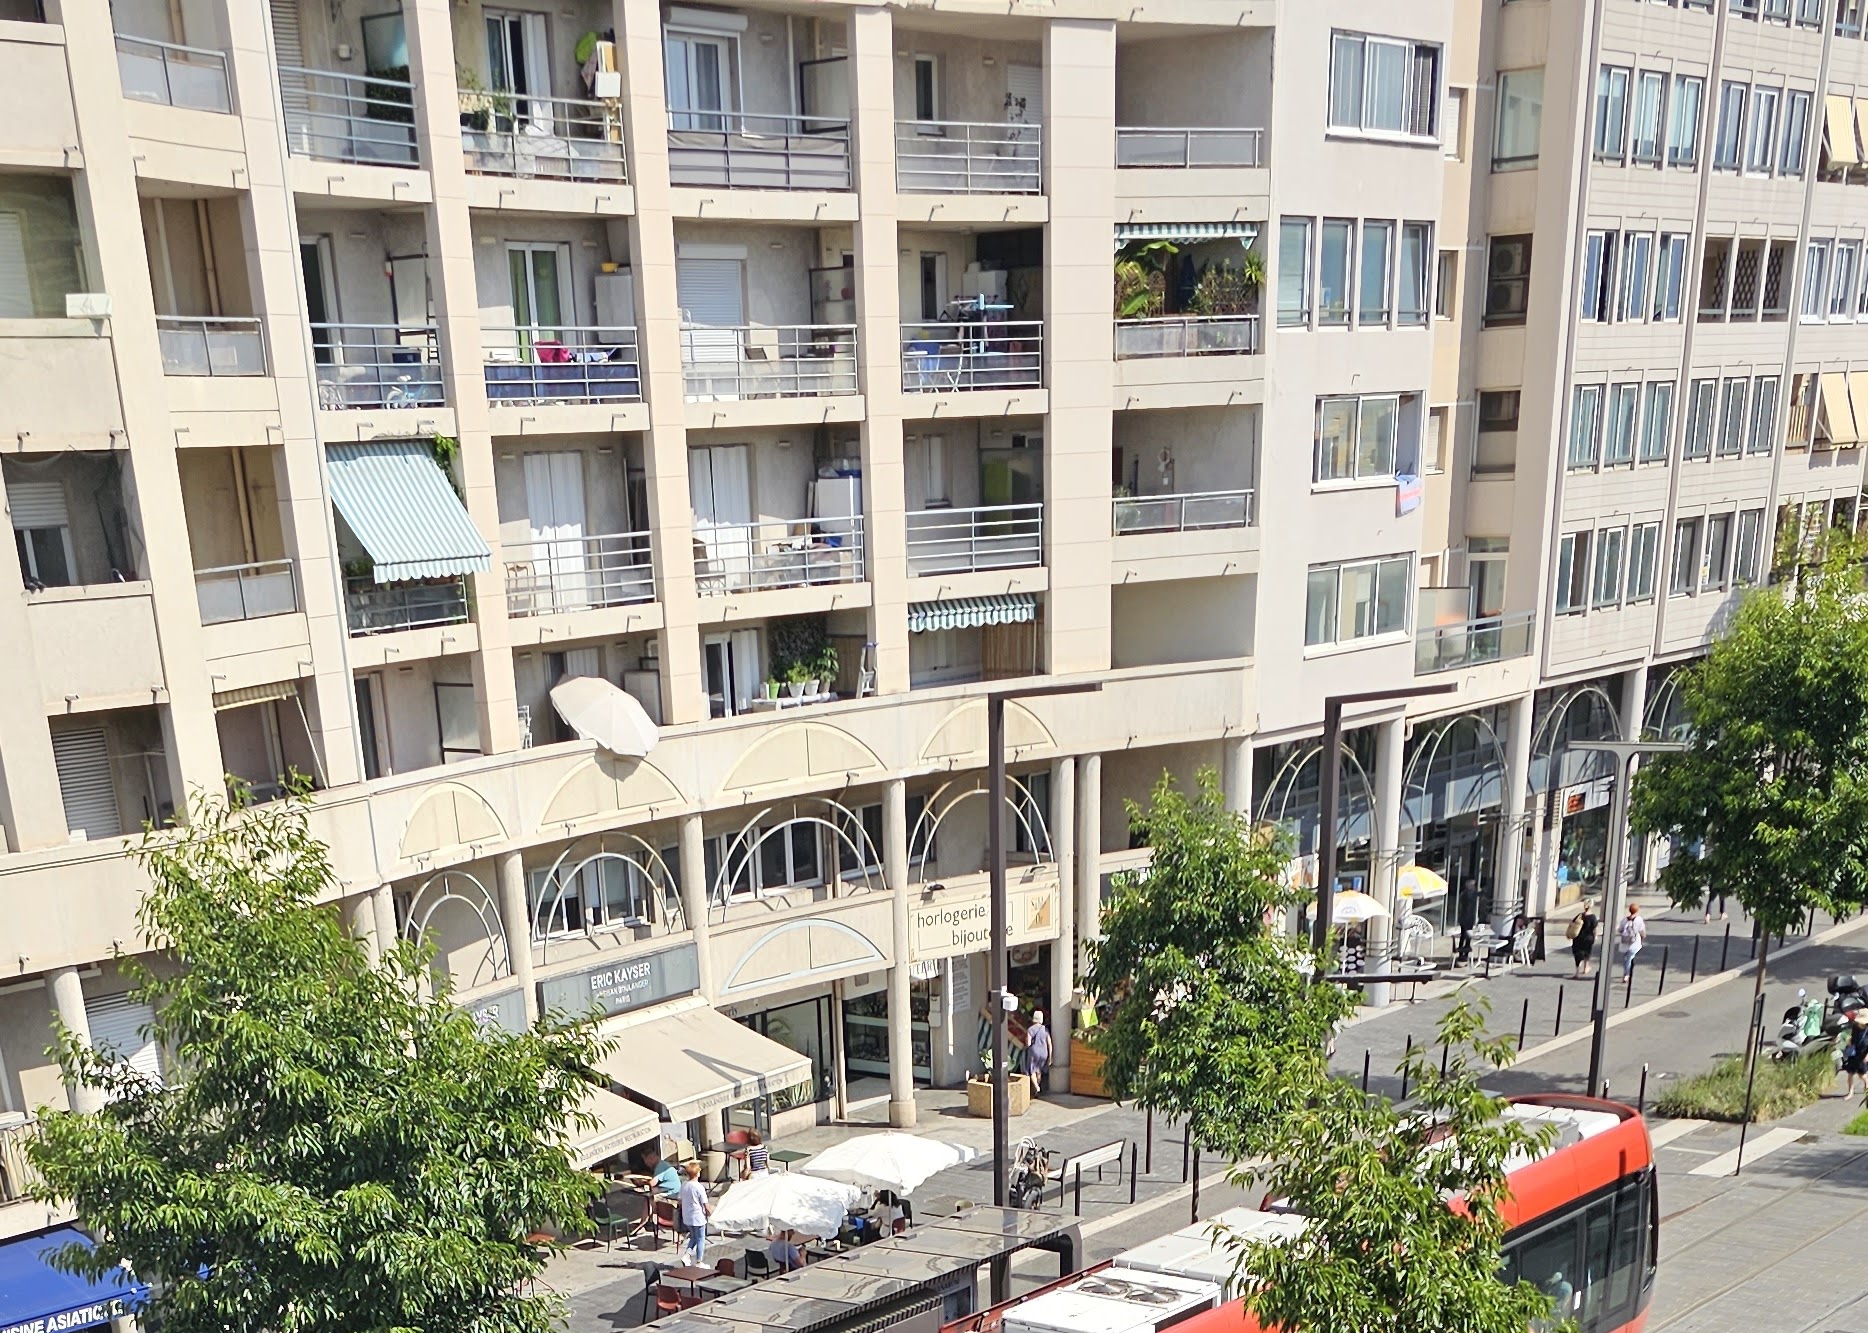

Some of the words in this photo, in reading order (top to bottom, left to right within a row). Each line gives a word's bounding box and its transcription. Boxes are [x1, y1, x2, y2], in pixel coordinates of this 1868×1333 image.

[917, 903, 986, 928] horlogerie
[951, 925, 1014, 948] bijoute
[590, 971, 613, 990] ERIC
[613, 962, 651, 984] KAYSER
